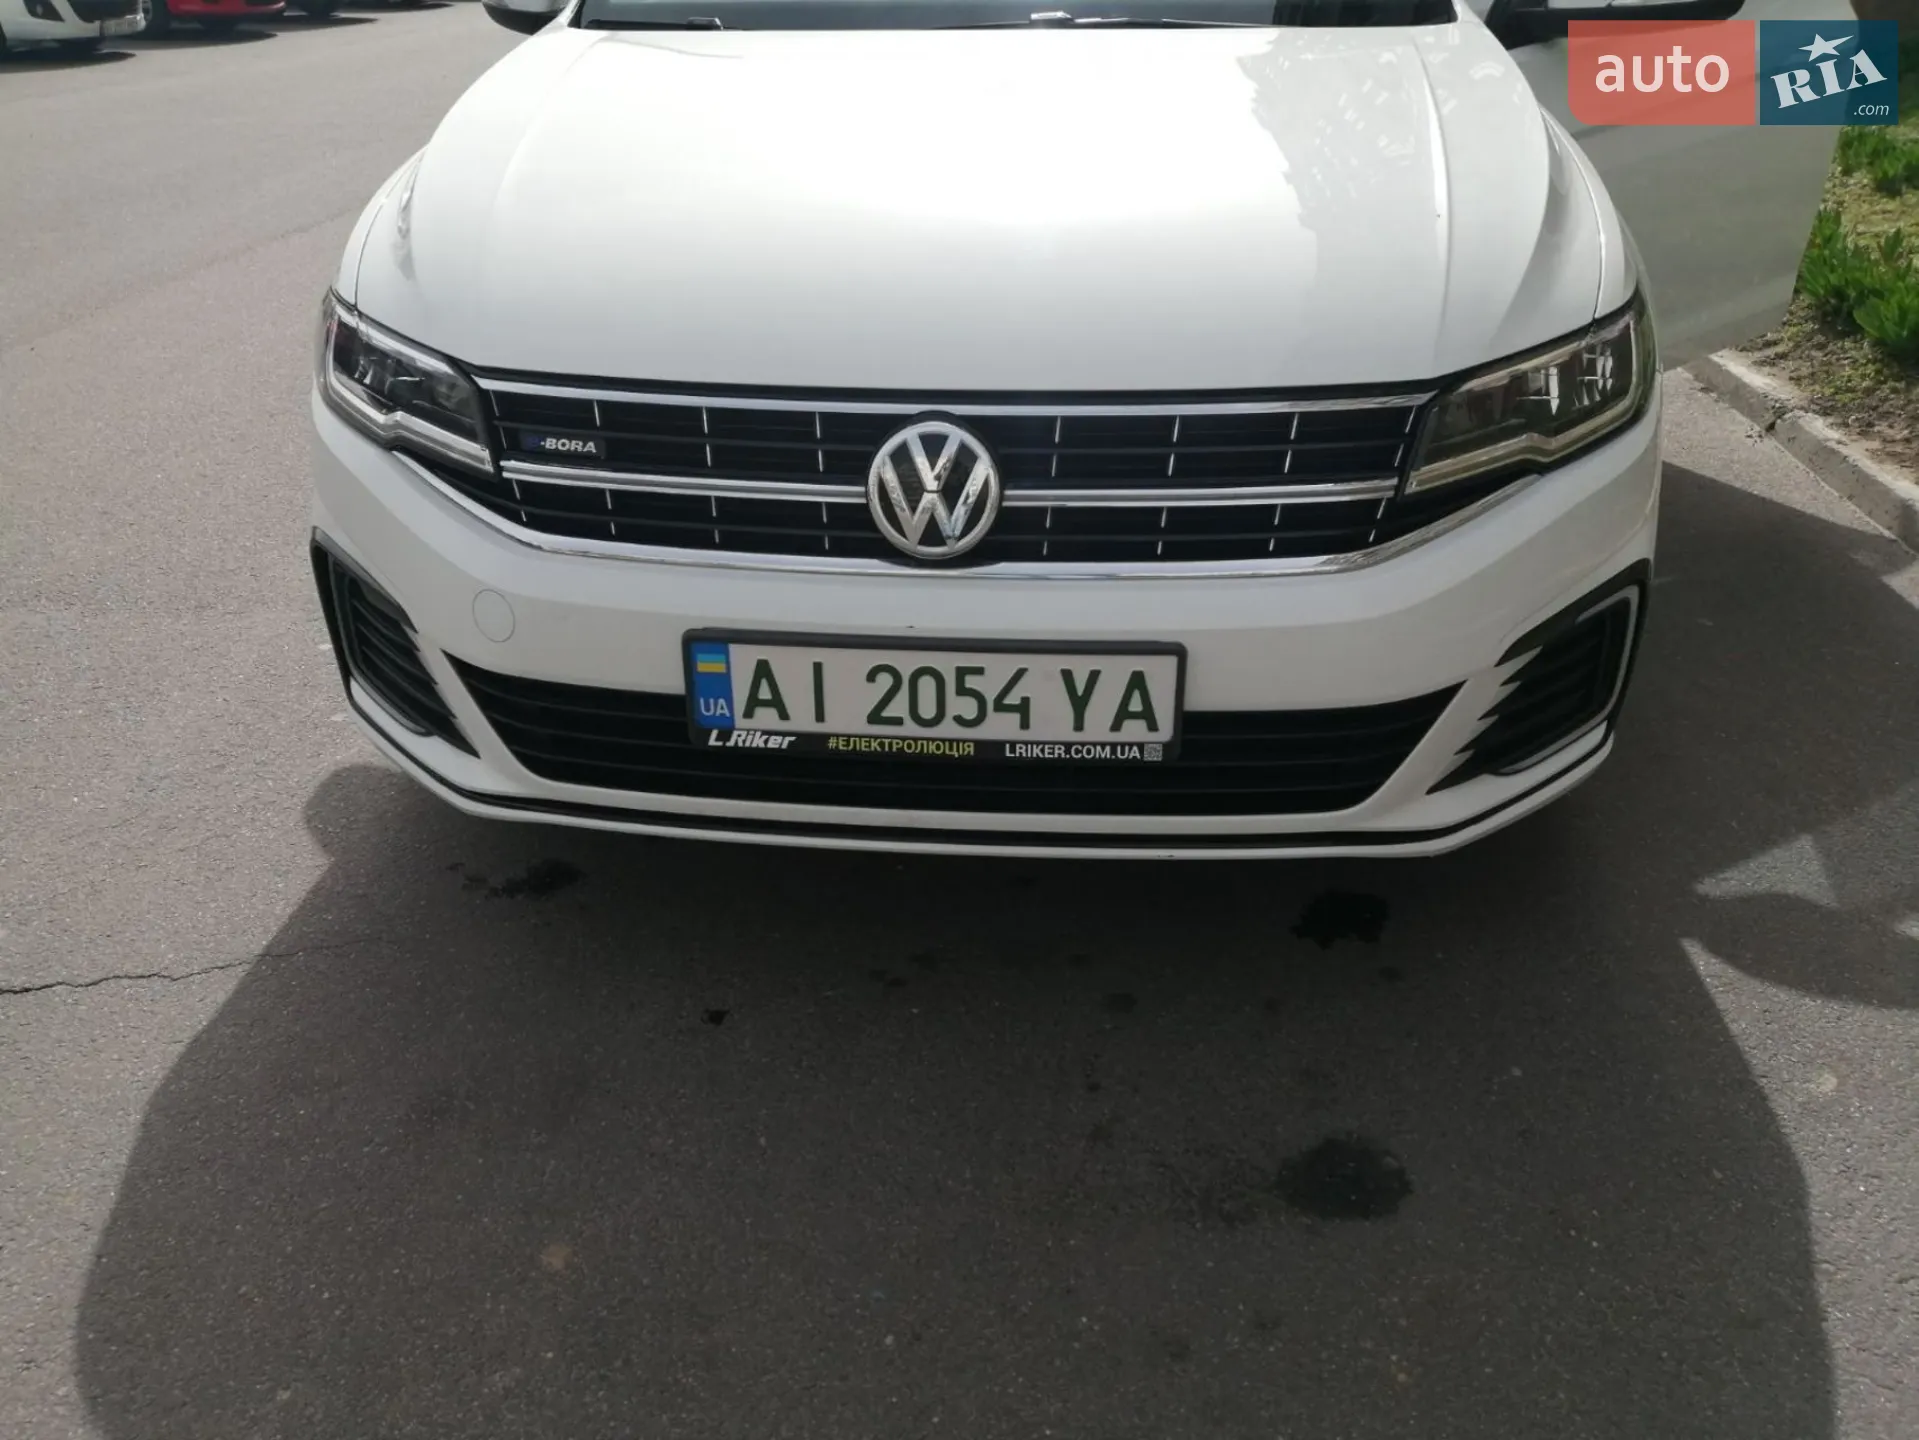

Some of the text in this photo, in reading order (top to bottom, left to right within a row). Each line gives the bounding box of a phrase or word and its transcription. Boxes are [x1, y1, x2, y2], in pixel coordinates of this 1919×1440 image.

[742, 658, 1160, 733] AI 2054 YA
[700, 698, 730, 717] UA
[828, 736, 975, 757] #ЕЛЕКТРОЛЮЦІЯ
[1005, 743, 1141, 759] LRIKER.COM.UA
